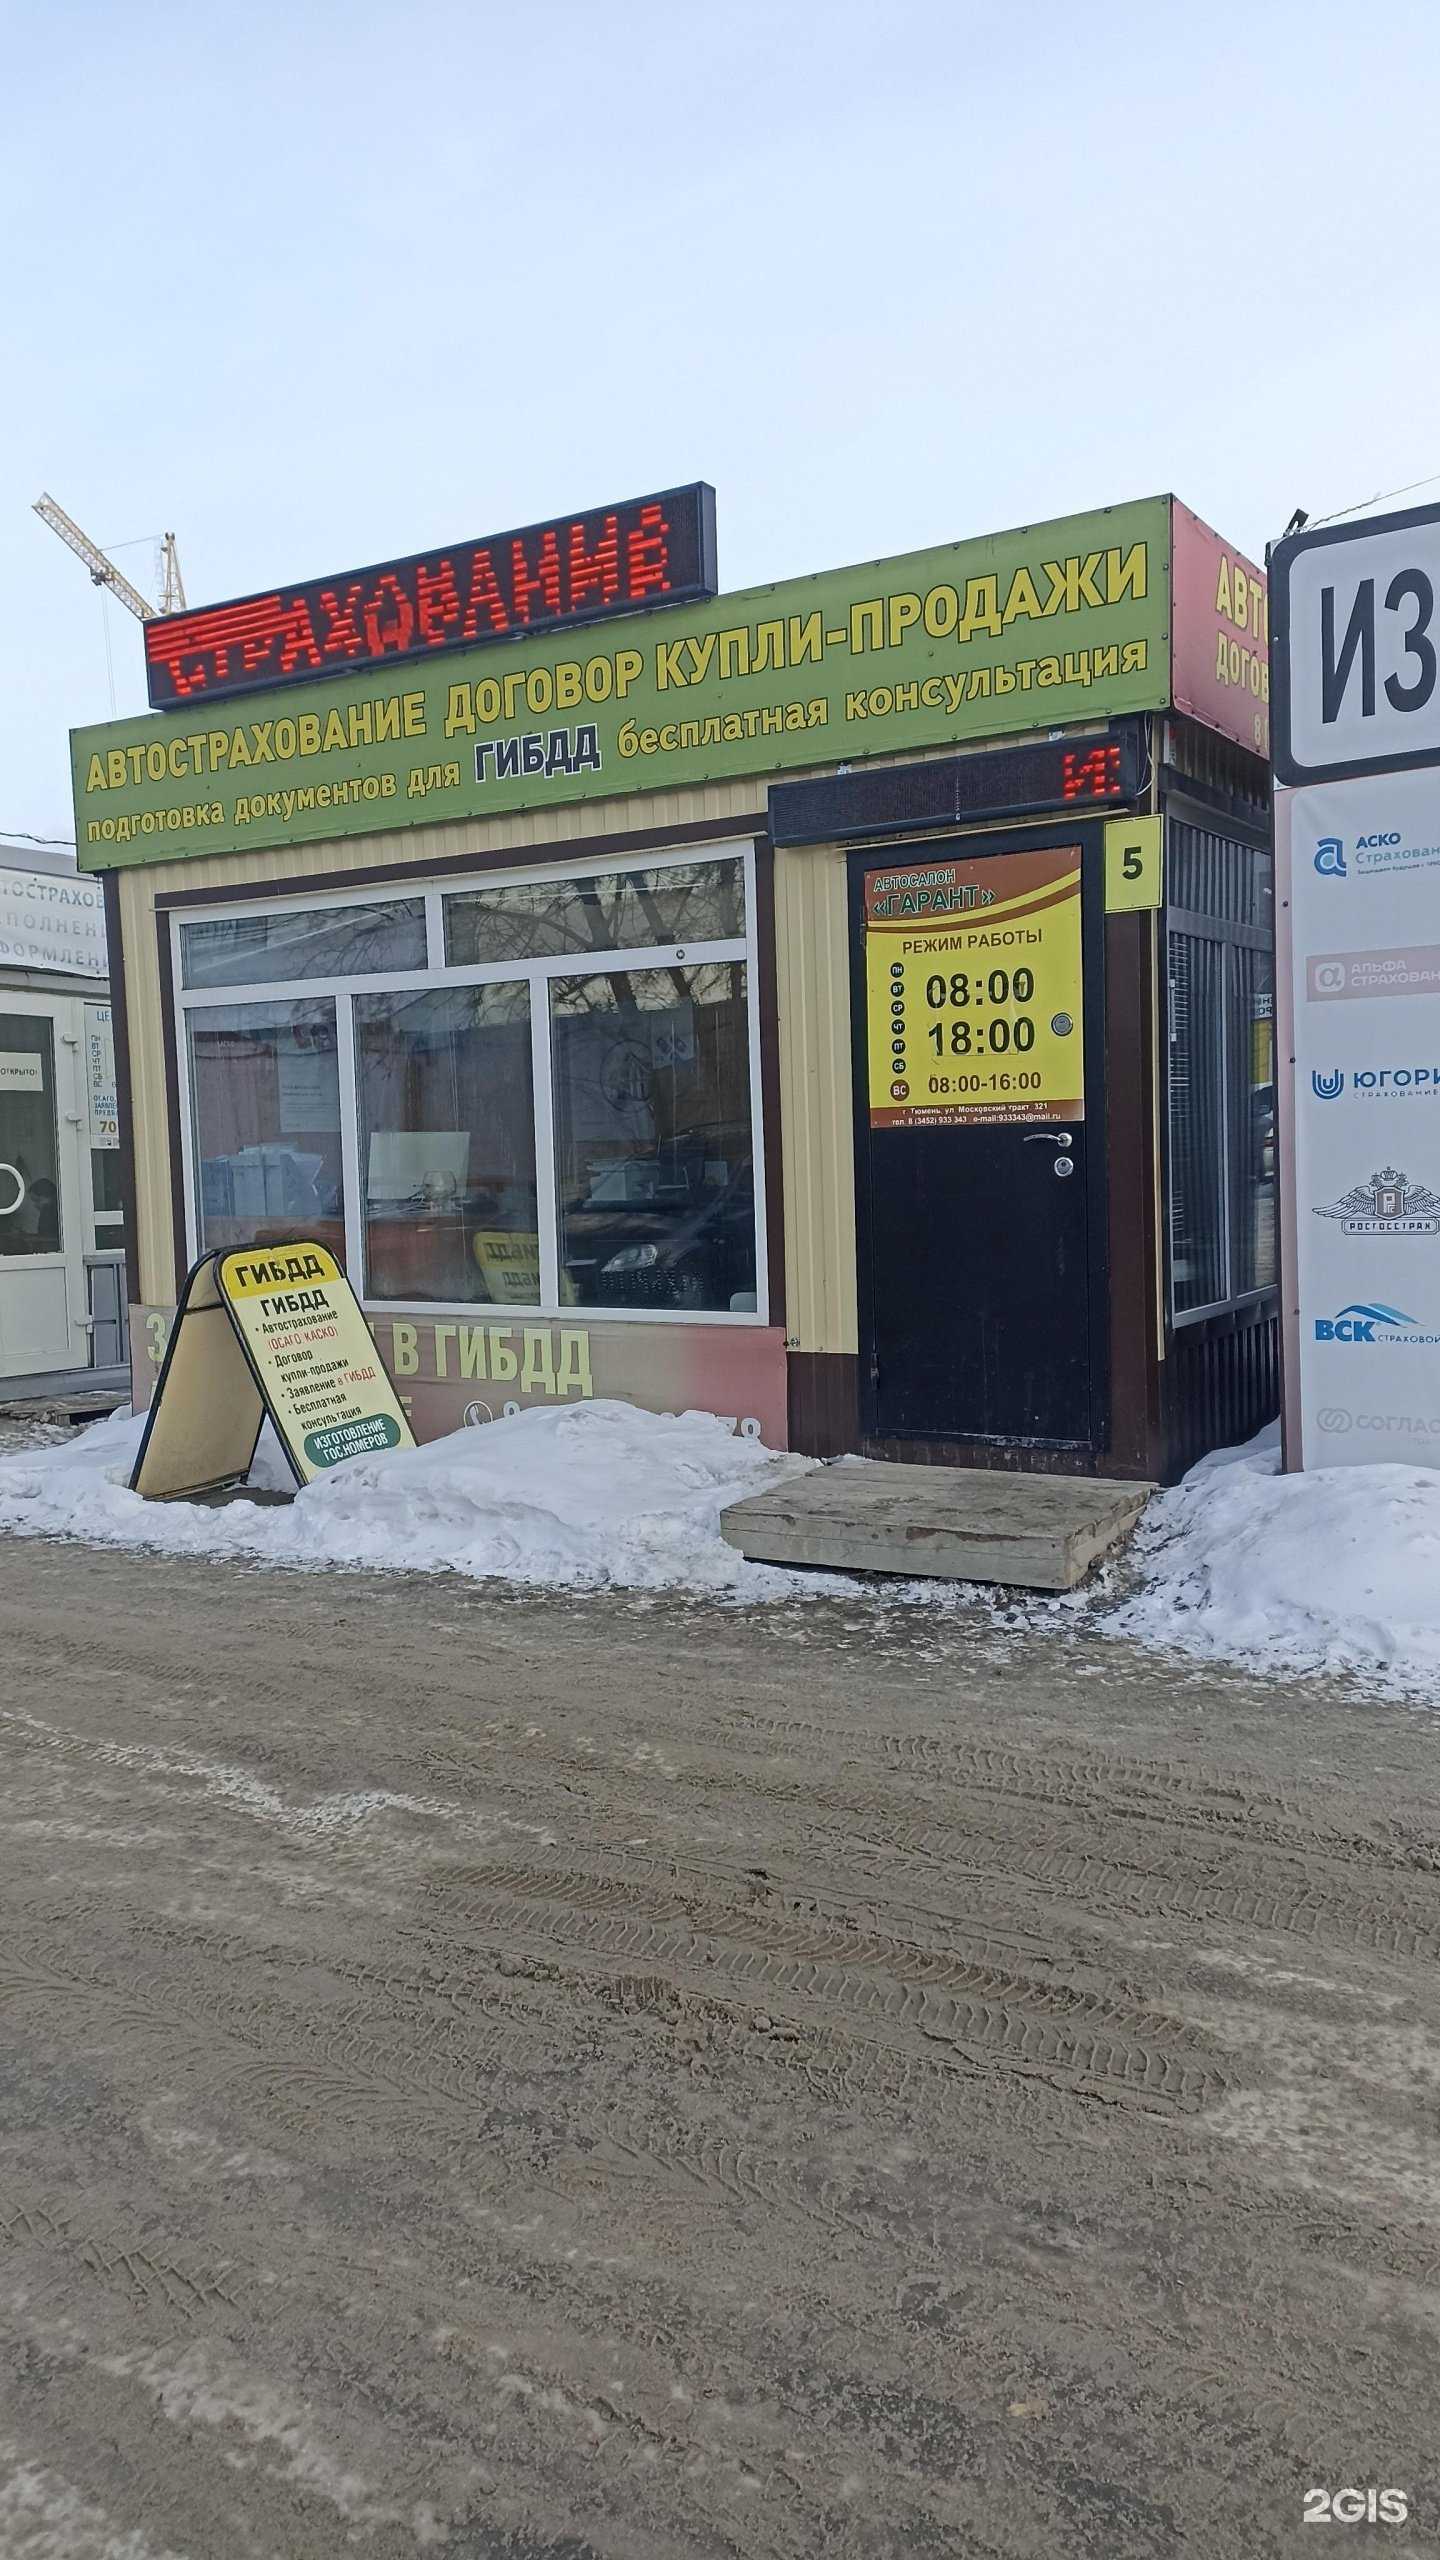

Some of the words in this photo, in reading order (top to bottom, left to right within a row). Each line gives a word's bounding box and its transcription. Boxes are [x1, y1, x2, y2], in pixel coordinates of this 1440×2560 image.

[1320, 567, 1437, 725] ИЗ
[86, 691, 426, 792] АВТОСТРАХОВАНИЕ
[444, 649, 644, 739] ДОГОВОР
[656, 541, 1148, 692] КУПЛИ-ПРОДАЖИ
[87, 801, 225, 843] подготовка
[234, 772, 397, 826] документов
[408, 761, 460, 798] для
[474, 722, 602, 783] ГИБДД
[616, 696, 829, 759] бесплатная
[845, 638, 1148, 722] консультация
[1355, 832, 1402, 850] АСКО
[1121, 846, 1144, 880] 5
[874, 868, 956, 893] АВТОСАЛОН
[873, 884, 997, 917] «ГАРАНТ»
[903, 935, 962, 955] РЕЖИМ
[967, 928, 1043, 949] РАБОТЫ
[1351, 959, 1407, 975] АЛЬФА
[926, 967, 1035, 1009] 08:00
[927, 1016, 1036, 1057] 18:00
[893, 1085, 907, 1096] ВС
[928, 1072, 1042, 1094] 08:00-16:00
[938, 1116, 952, 1124] 933
[954, 1115, 967, 1123] 343
[1349, 1222, 1431, 1231] РОСГОССТРАХ
[235, 1254, 325, 1287] ГИБДД
[260, 1289, 330, 1317] ГИБДД
[263, 1310, 339, 1334] Автострахование
[1315, 1319, 1376, 1342] ВСК
[275, 1350, 314, 1368] Договор
[281, 1359, 350, 1384] купли-продажи
[393, 1323, 419, 1375] В
[434, 1324, 593, 1397] ГИБДД
[287, 1378, 336, 1399] Заявление
[344, 1366, 377, 1384] ГИБДД
[293, 1393, 347, 1415] Бесплатная
[301, 1406, 362, 1431] консультация
[313, 1418, 386, 1450] ИЗГОТОВЛЕНИЕ
